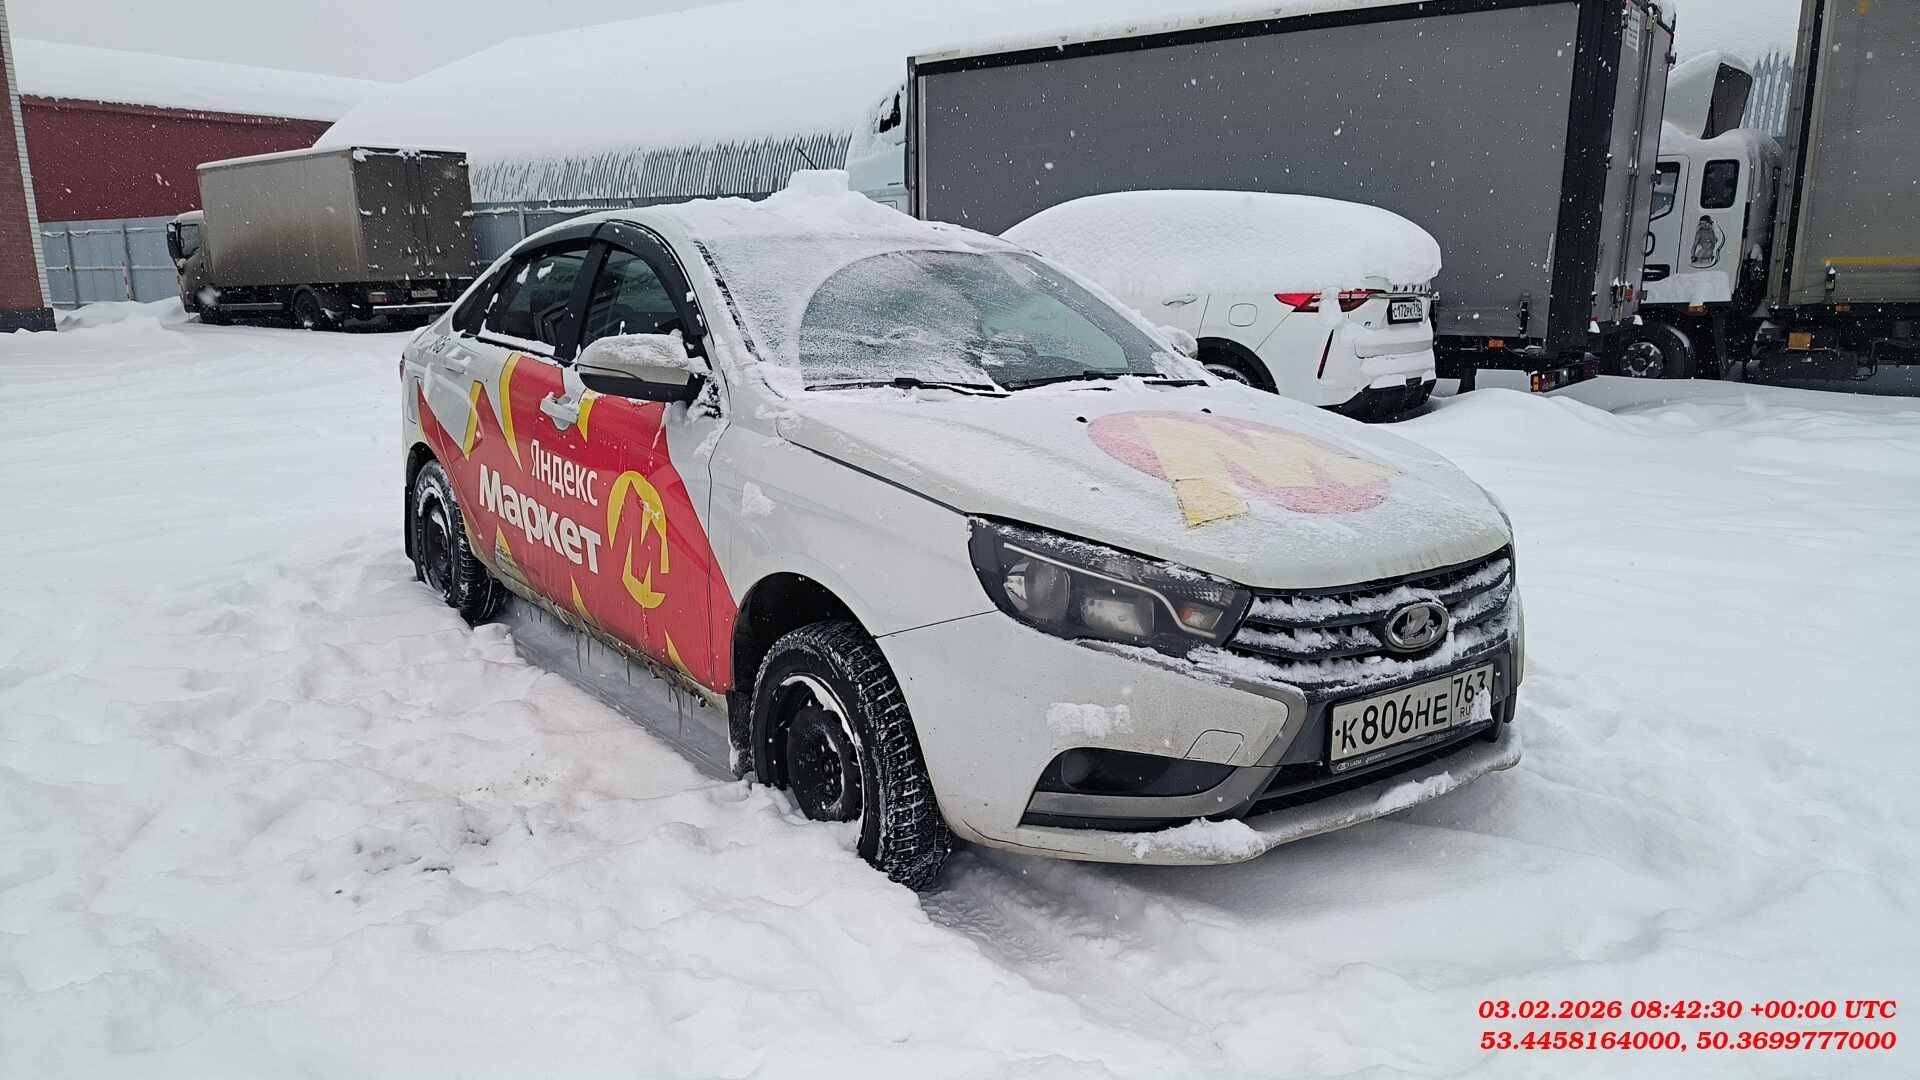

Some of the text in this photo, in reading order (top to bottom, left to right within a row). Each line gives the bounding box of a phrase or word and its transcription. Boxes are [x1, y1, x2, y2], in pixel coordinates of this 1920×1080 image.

[531, 439, 599, 507] Яндекс
[479, 463, 602, 576] Маркет
[1341, 694, 1448, 752] К806НЕ
